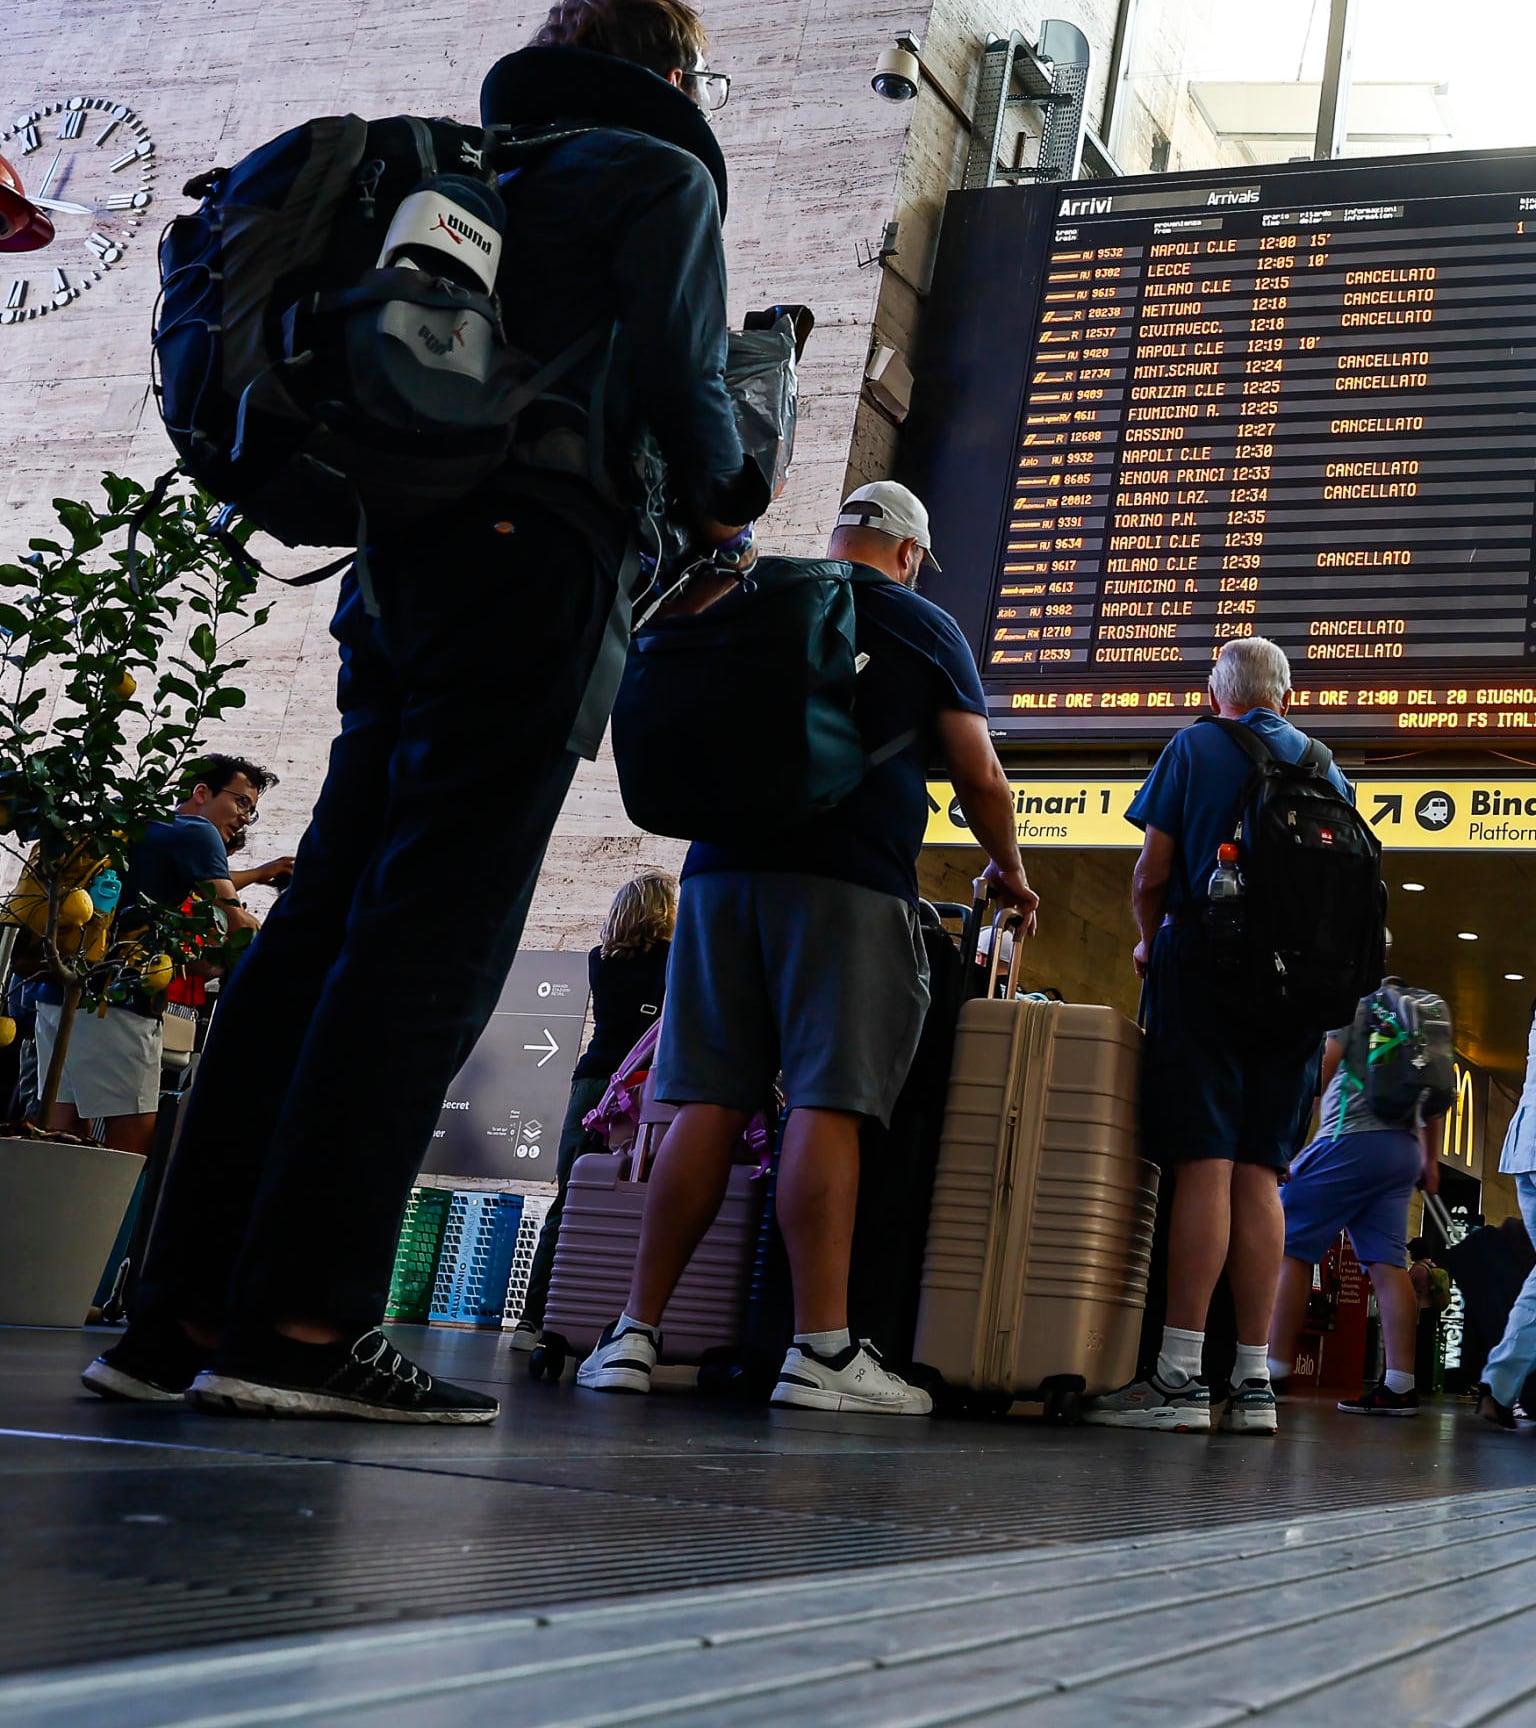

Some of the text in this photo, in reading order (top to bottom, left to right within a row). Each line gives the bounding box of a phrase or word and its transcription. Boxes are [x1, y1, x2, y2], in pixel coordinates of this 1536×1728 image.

[1058, 190, 1260, 217] Arrivi Arrivals
[1097, 247, 1124, 259] 9532
[1150, 241, 1200, 258] NAPOLI
[1206, 239, 1237, 254] C.LE
[1259, 235, 1297, 251] 12:00
[1515, 221, 1526, 235] 1
[1147, 262, 1192, 278] LECCE
[1257, 255, 1295, 270] 12:05
[1144, 267, 1436, 298] MILANO C.LE 12:15 CANCELLATO
[1141, 288, 1434, 318] NETTUNO 12:18 CANCELLATO
[1139, 317, 1285, 338] CIVITAVECC. 12:18
[1134, 351, 1429, 379] MINT.SCAURI 12:24 CANCELLATO
[1131, 380, 1281, 400] GORIZIA C.LE 12:25
[1125, 422, 1277, 442] CASSINO 12:27
[1316, 550, 1411, 567] CANCELLATO
[1098, 619, 1406, 640] FROSINONE CANCELLATO
[1011, 693, 1058, 709] DALLE
[1064, 693, 1095, 708] ORE
[1100, 692, 1141, 707] 21:00
[1146, 692, 1175, 707] DEL
[1183, 692, 1203, 707] 19
[1318, 690, 1350, 706] ORE
[1357, 690, 1400, 705] 21:00
[1406, 689, 1437, 705] DEL
[1445, 689, 1468, 705] 20
[1397, 712, 1459, 728] GRUPPO
[1466, 712, 1489, 728] FS
[1100, 790, 1110, 815] 1
[449, 1261, 468, 1320] ALLUMINIO
